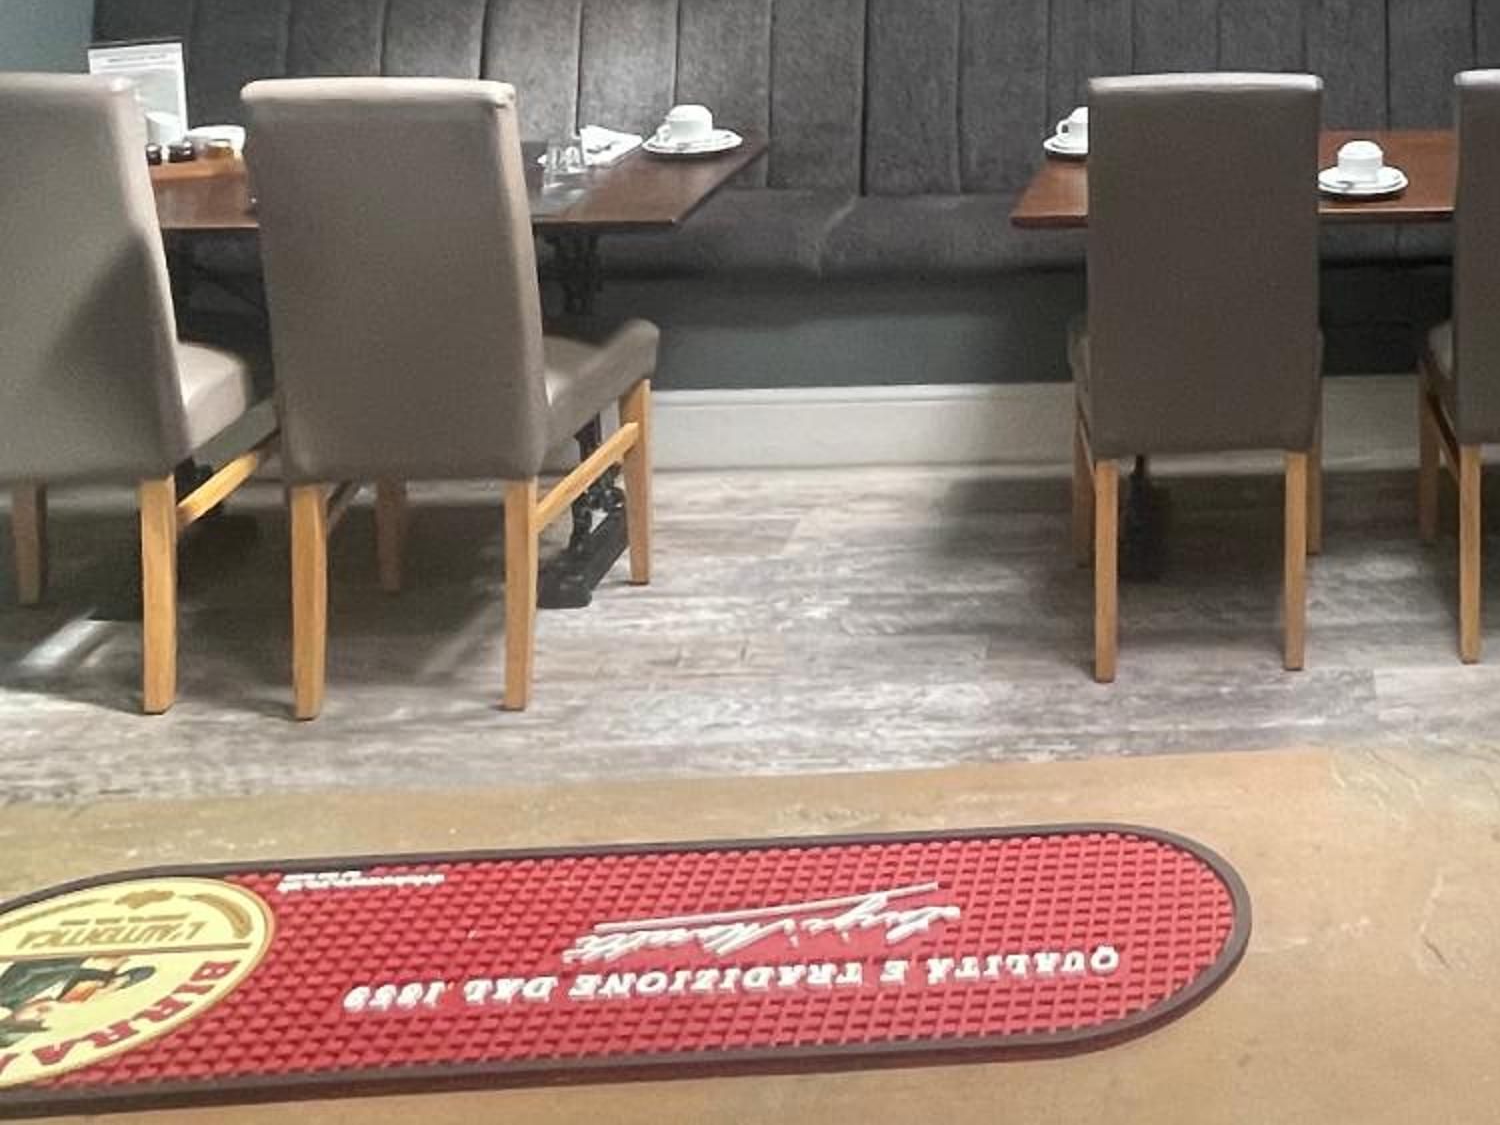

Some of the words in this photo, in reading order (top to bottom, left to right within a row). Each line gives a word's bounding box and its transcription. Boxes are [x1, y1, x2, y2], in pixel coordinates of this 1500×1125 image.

[568, 961, 863, 998] TRADIZIONE
[880, 960, 909, 985] E
[343, 981, 447, 1011] 1859
[463, 976, 558, 1002] DAL
[32, 960, 240, 1065] BIRRA
